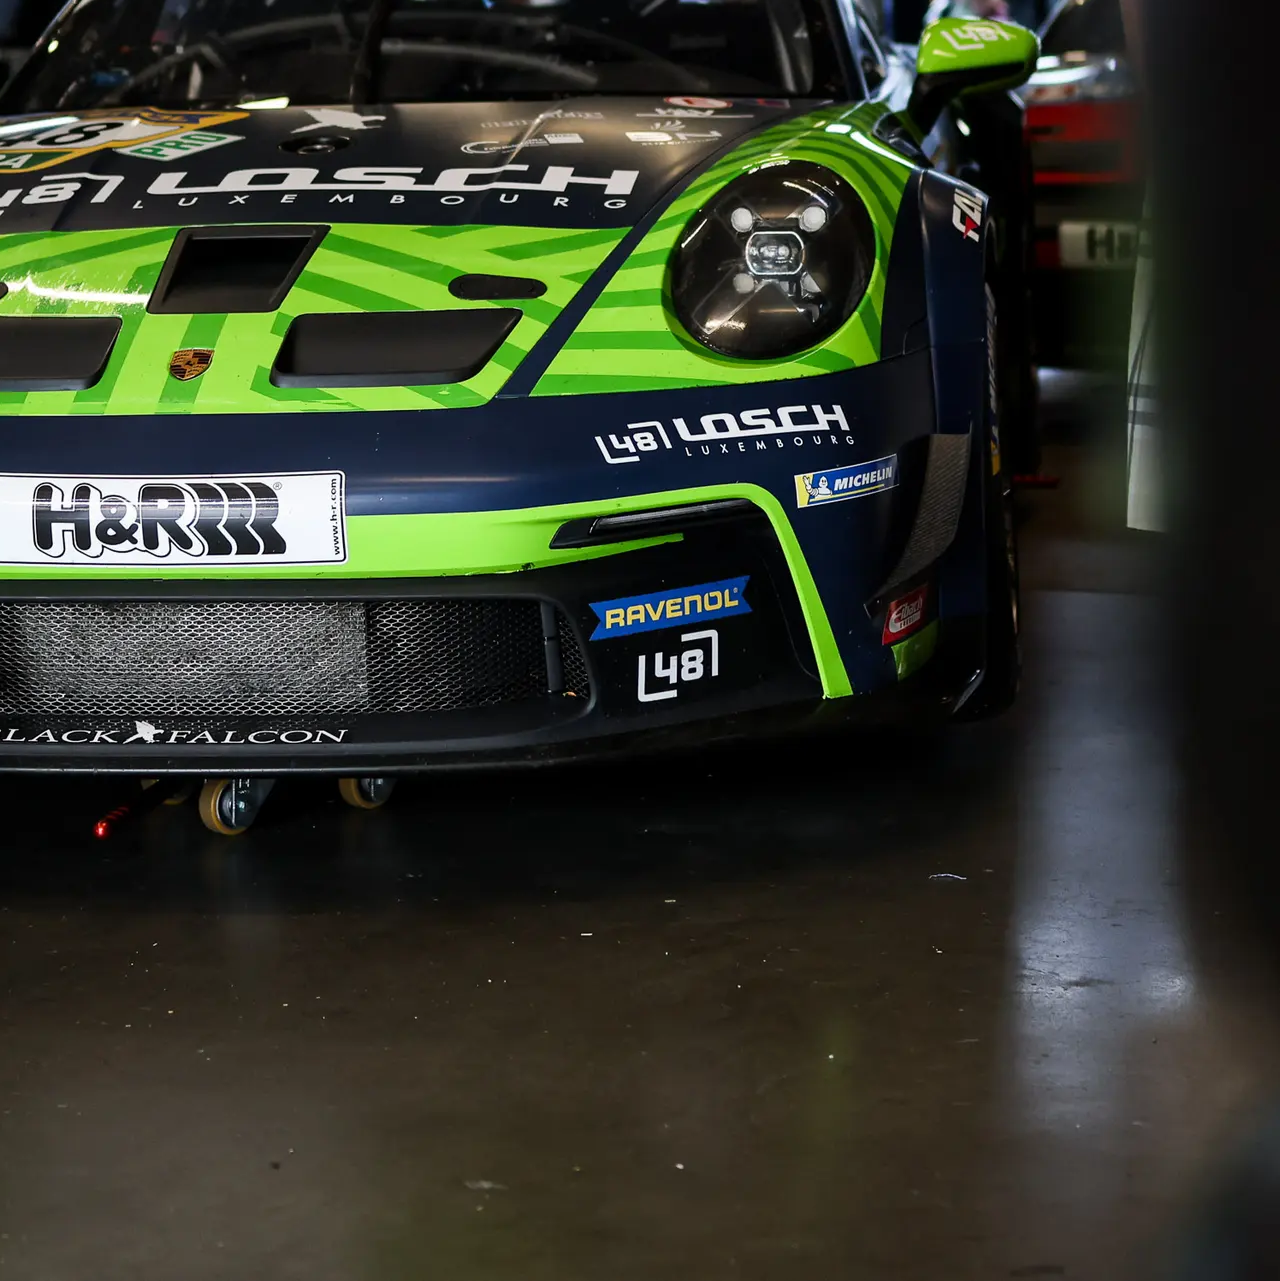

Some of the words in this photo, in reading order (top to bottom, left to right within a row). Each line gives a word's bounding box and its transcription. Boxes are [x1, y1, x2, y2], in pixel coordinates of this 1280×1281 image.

[129, 133, 227, 158] PRO
[147, 164, 639, 196] LOSCH
[132, 193, 628, 210] LUXEMBOURG
[672, 404, 851, 443] LOSCH
[685, 435, 855, 457] LUXEMBOURG
[833, 466, 893, 492] MICHELIN
[330, 478, 341, 556] www.h-r.com
[606, 588, 739, 629] RAVENOL
[165, 729, 348, 744] FALCON
